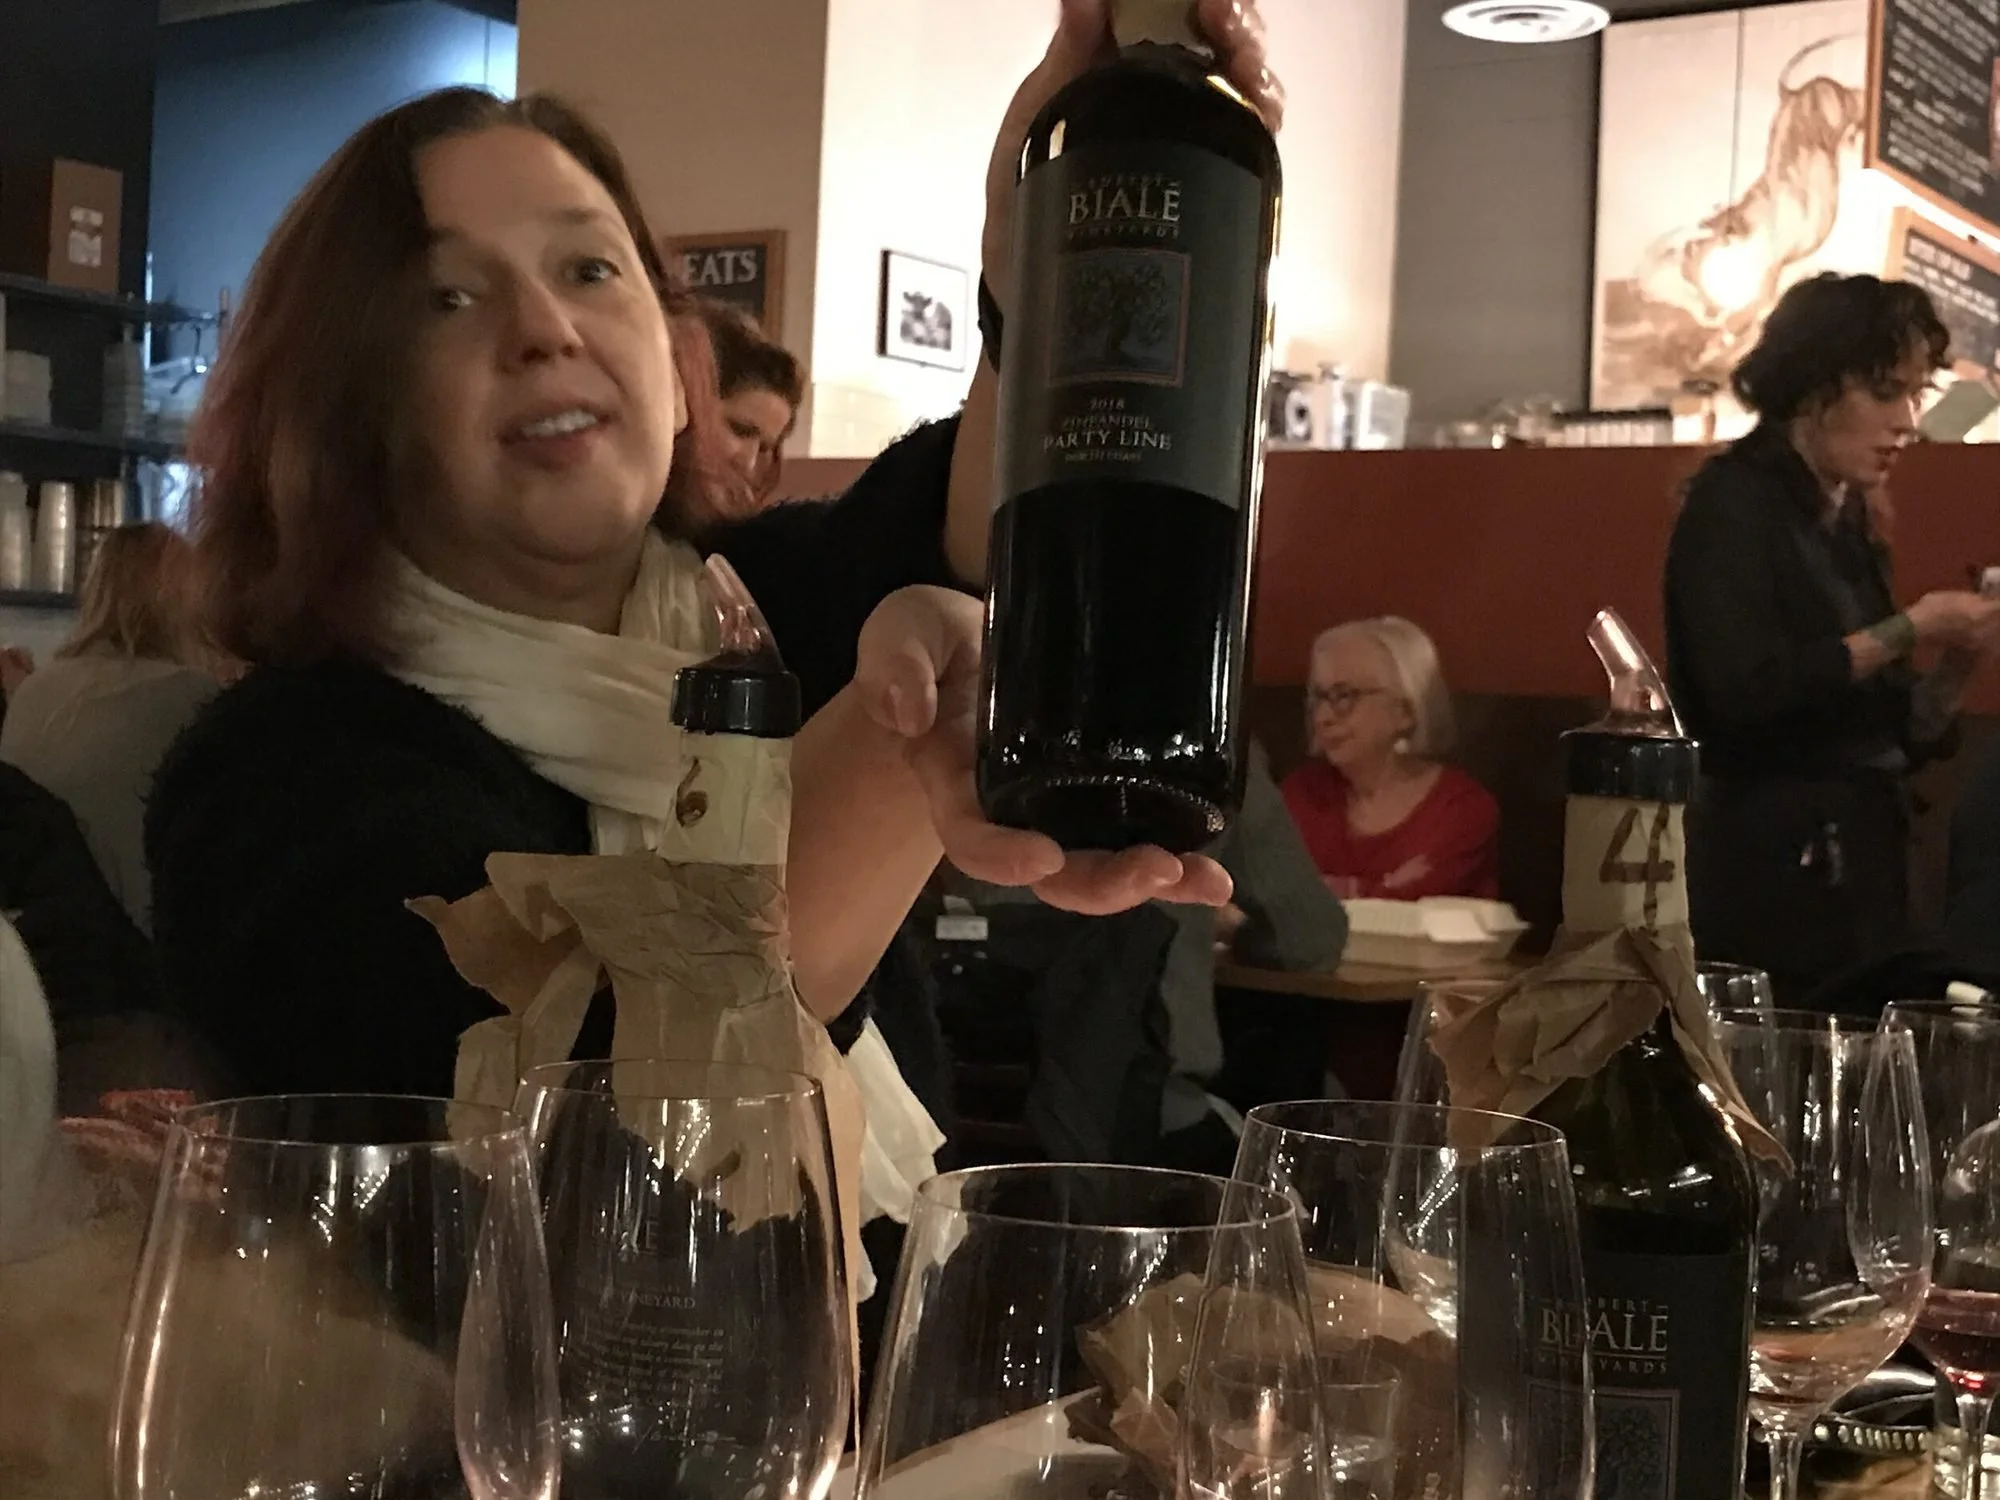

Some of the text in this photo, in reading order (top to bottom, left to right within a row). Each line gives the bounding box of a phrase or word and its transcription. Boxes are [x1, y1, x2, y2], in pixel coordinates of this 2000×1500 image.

[1069, 187, 1181, 224] BIALE
[1090, 397, 1126, 411] 2018
[1043, 429, 1173, 452] PARTY LINE
[676, 756, 708, 828] 6
[1599, 801, 1675, 928] 4
[1540, 1308, 1669, 1351] BIALE
